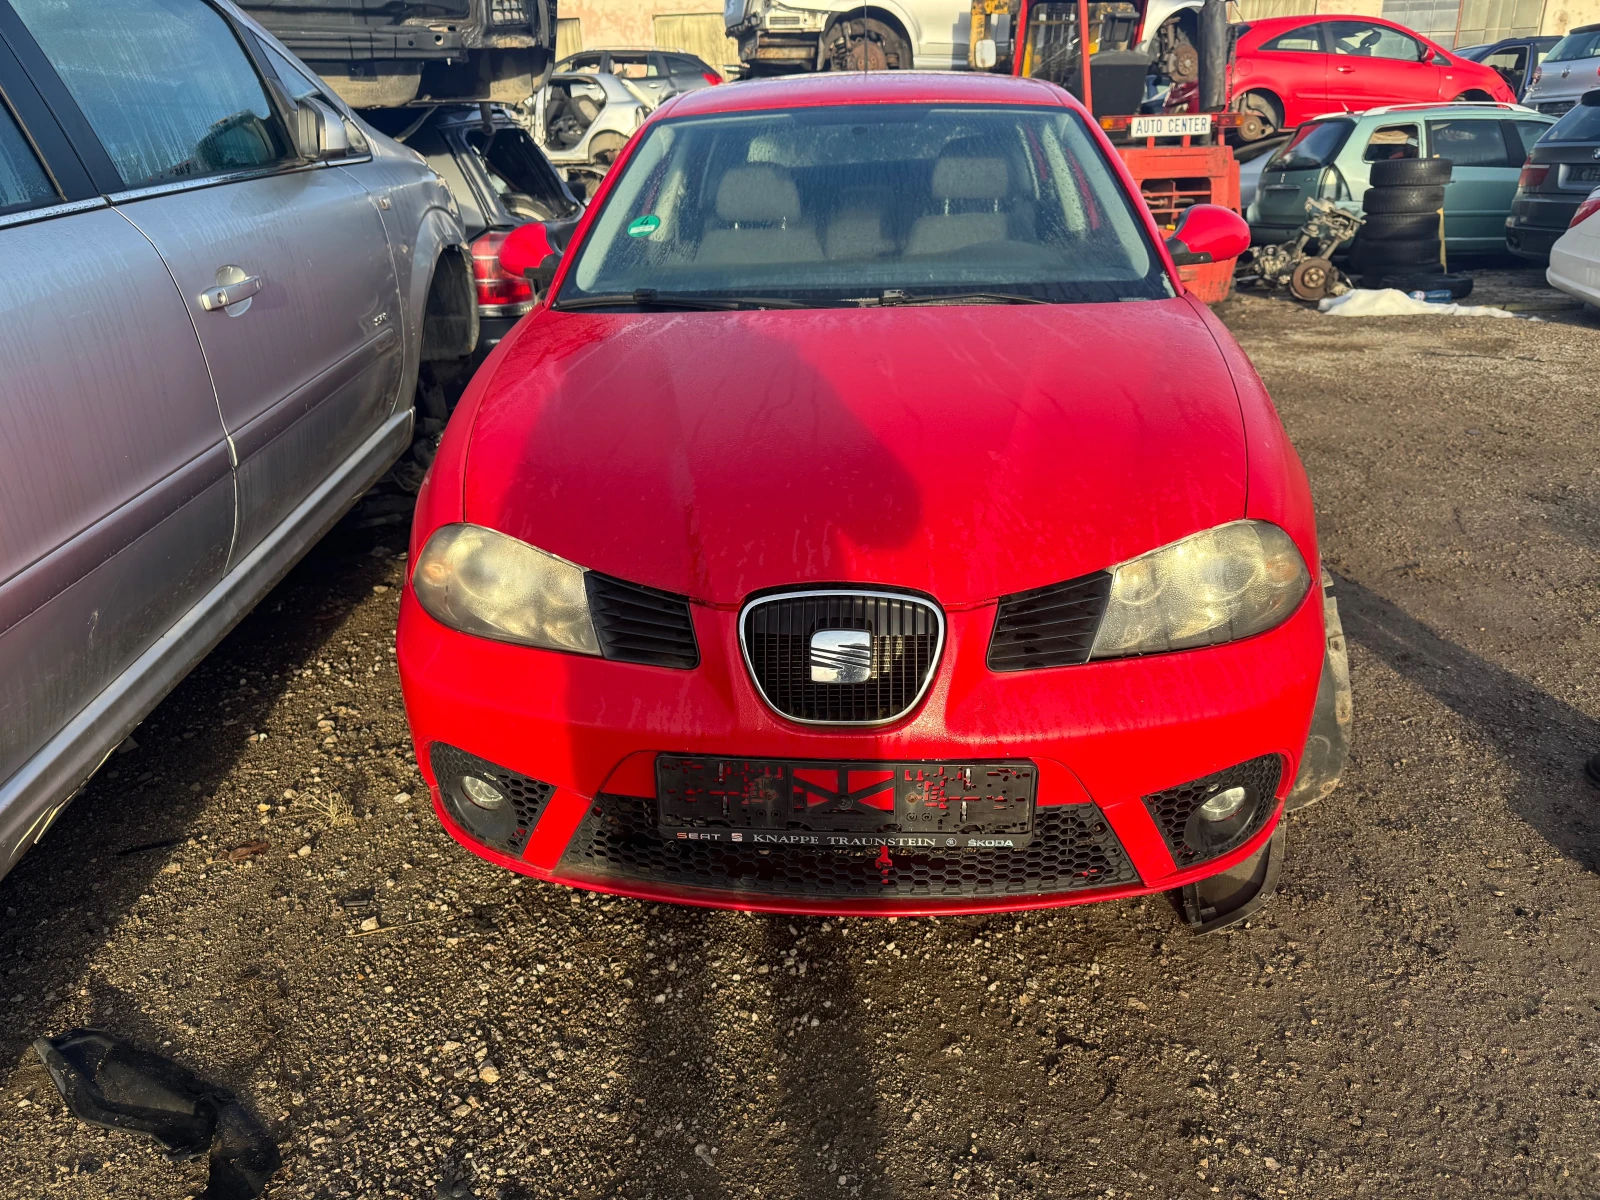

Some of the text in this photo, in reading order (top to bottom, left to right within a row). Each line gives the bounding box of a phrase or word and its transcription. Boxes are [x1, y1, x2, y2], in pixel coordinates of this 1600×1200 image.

[1136, 117, 1207, 134] AUTO CENTER
[640, 216, 650, 226] 4
[676, 832, 1014, 847] SEAT KNAPPE TRAUNSTEIN ŠKODA
